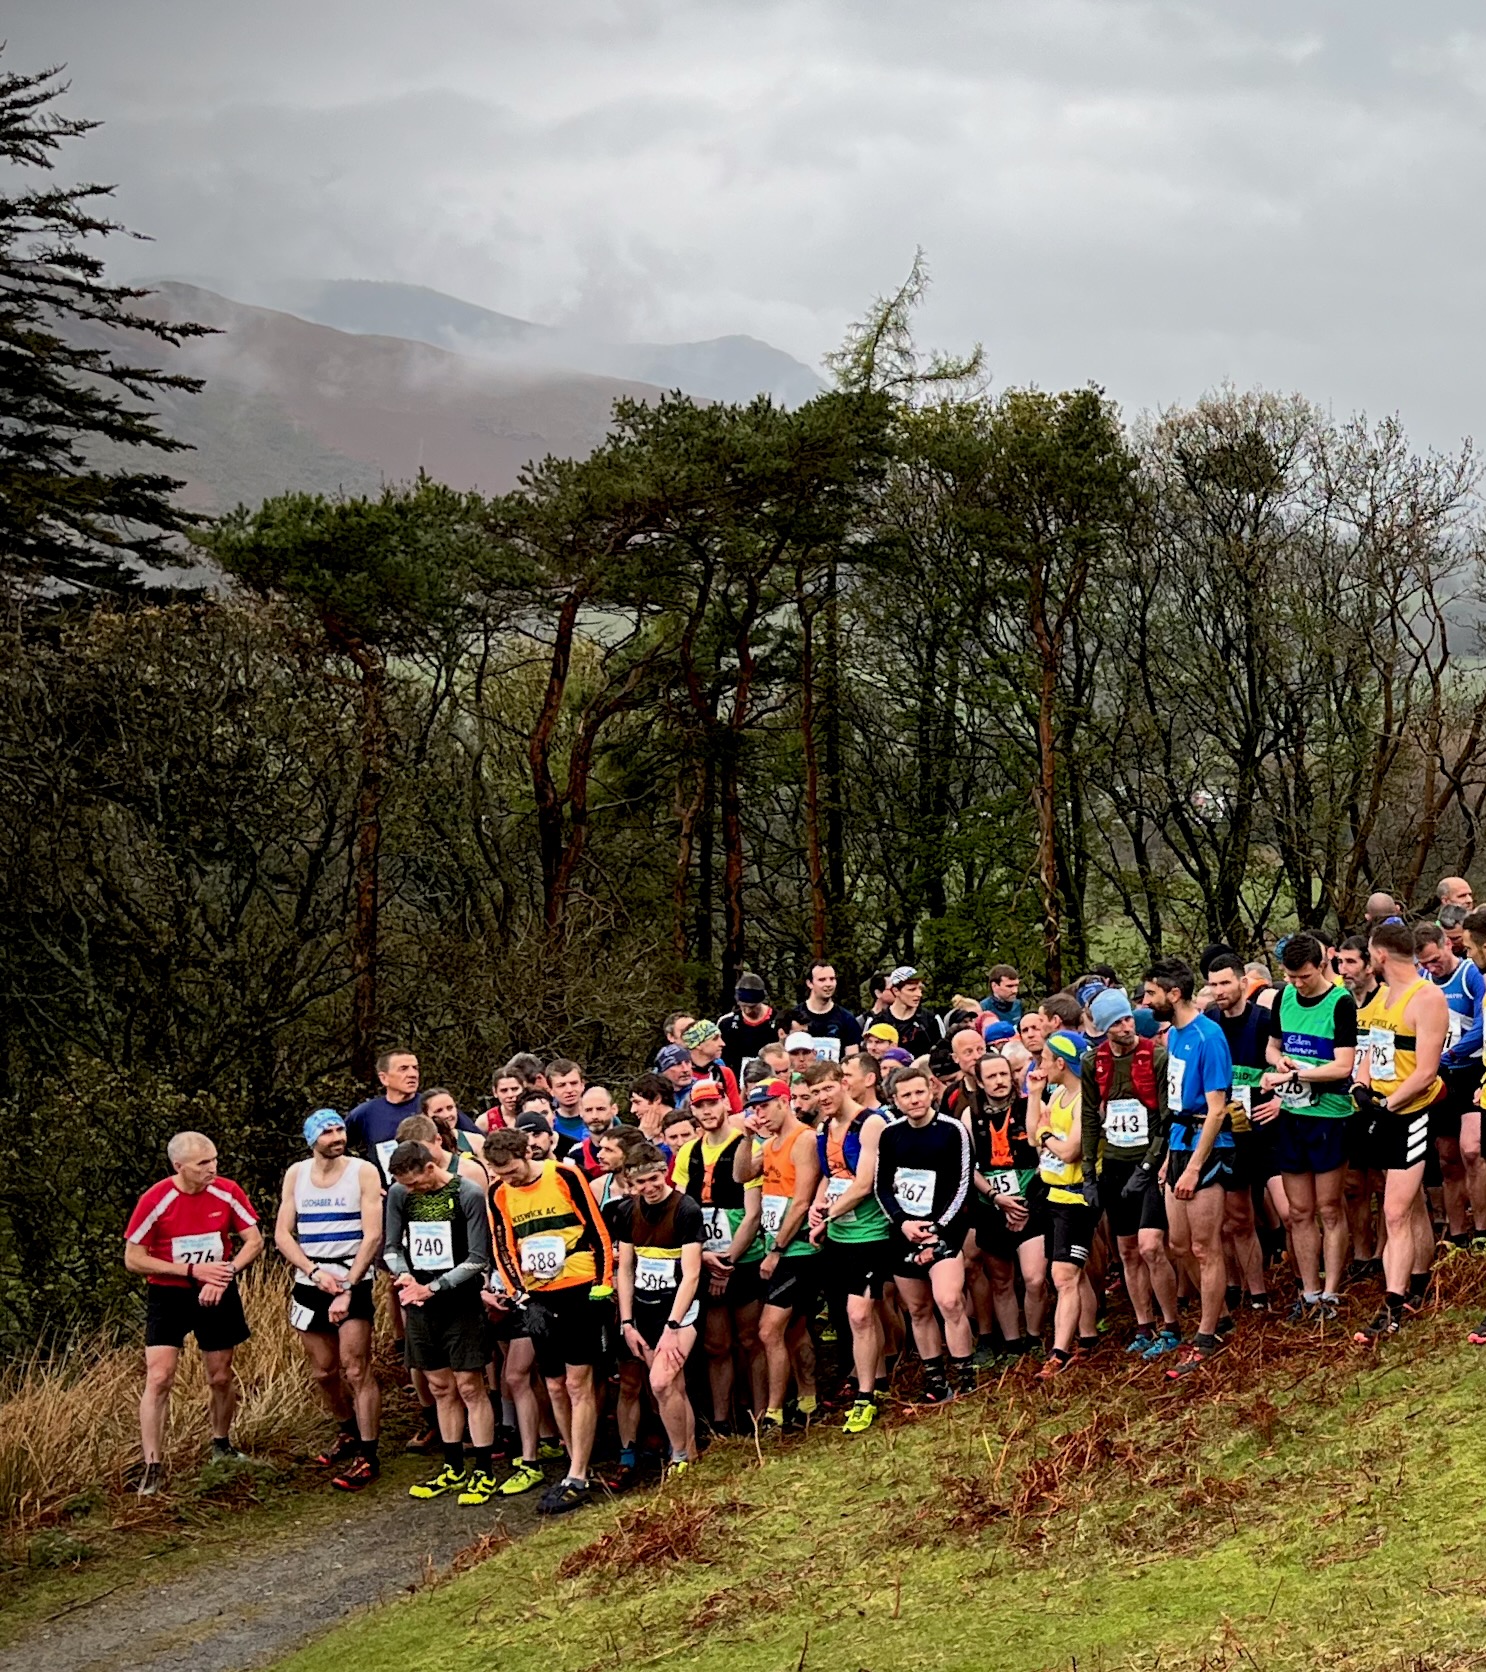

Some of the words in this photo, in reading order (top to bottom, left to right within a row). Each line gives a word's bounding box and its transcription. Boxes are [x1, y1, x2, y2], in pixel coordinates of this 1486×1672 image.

[512, 1209, 543, 1223] KESWICK
[545, 1207, 556, 1215] AC
[415, 1238, 444, 1257] 240
[528, 1252, 557, 1272] 388
